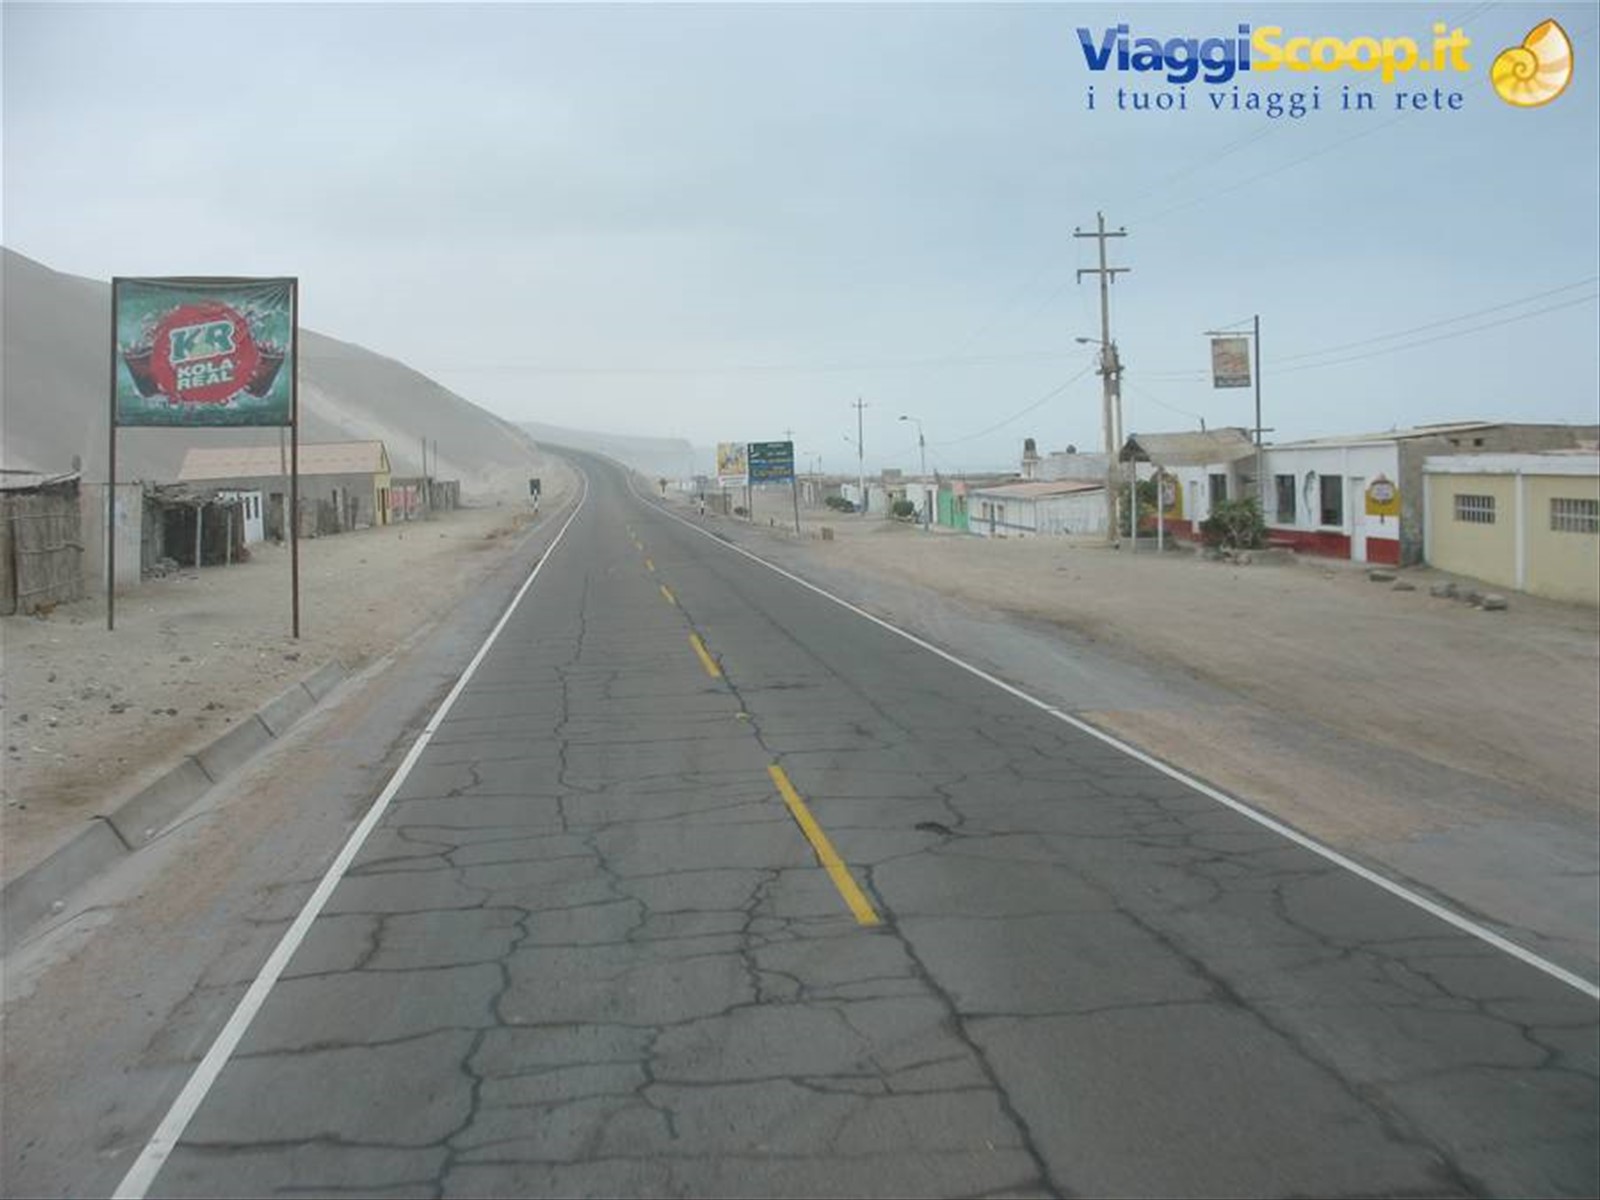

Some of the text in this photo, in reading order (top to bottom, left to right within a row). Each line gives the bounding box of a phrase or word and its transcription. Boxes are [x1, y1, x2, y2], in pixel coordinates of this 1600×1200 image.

[170, 321, 235, 364] KR
[177, 358, 233, 378] KOLA
[177, 371, 234, 390] REAL
